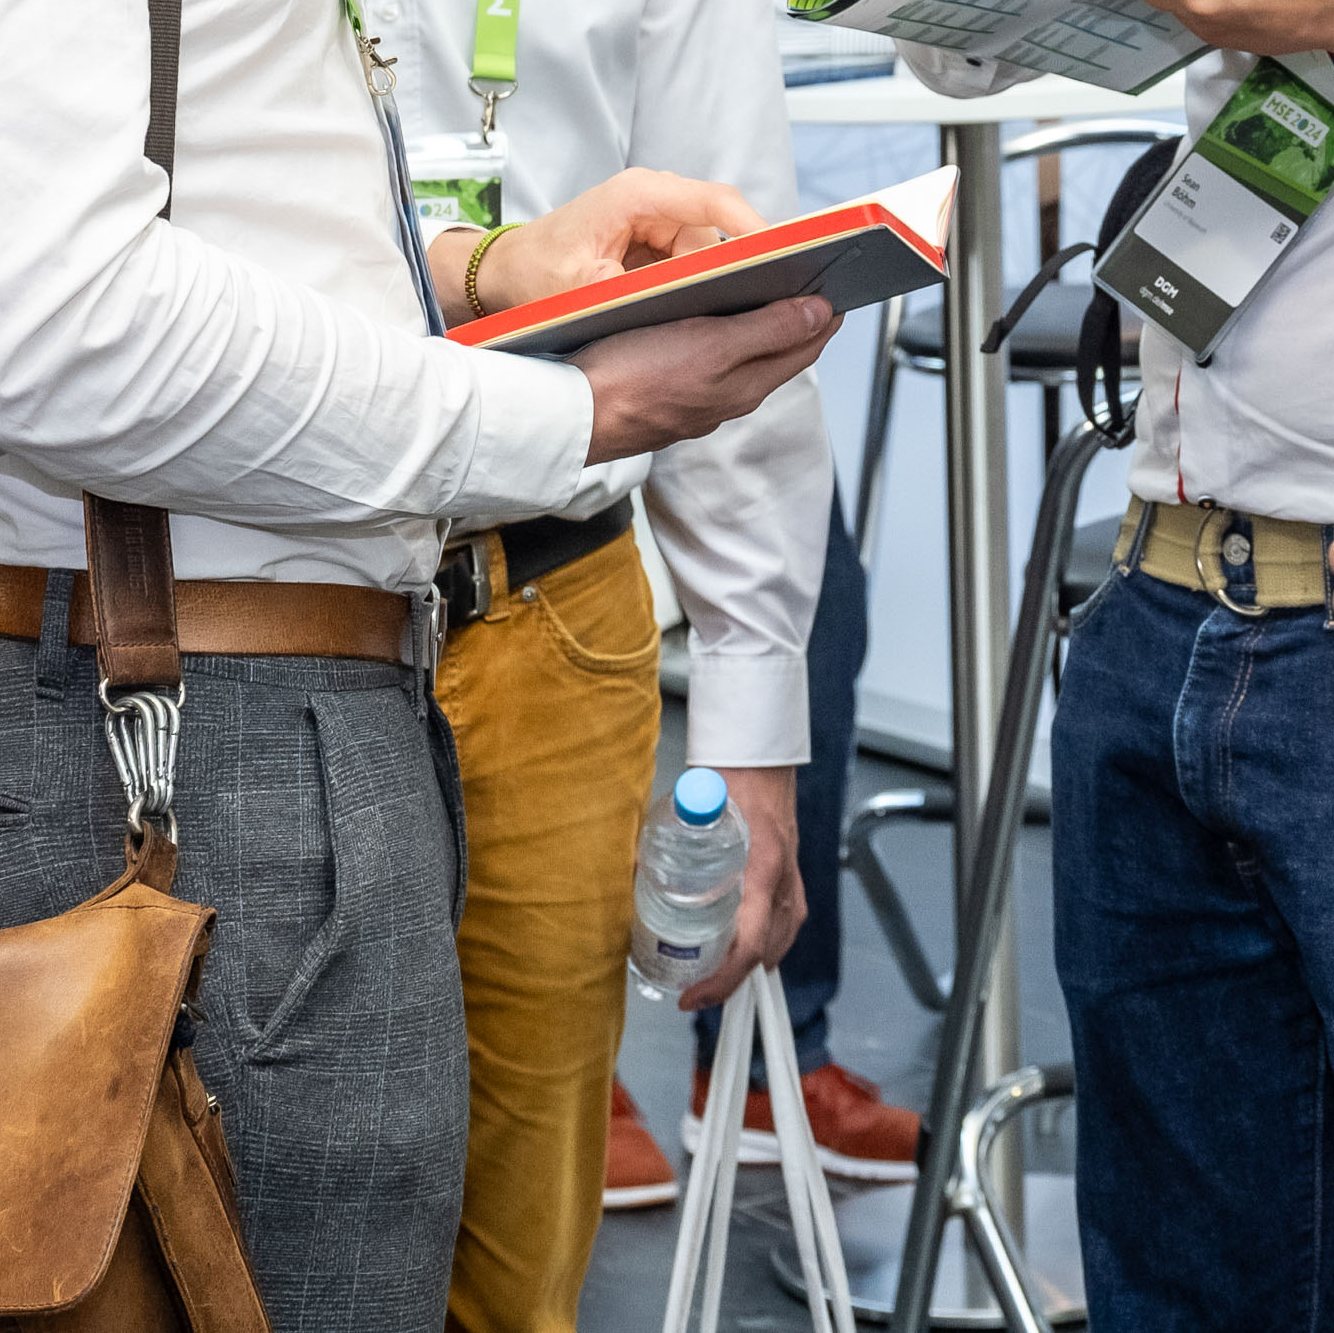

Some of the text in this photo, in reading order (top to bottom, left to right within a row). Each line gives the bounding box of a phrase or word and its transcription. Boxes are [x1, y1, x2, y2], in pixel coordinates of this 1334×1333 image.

[1266, 97, 1296, 122] MSE
[1182, 173, 1200, 192] Sean
[1154, 275, 1180, 299] DGM
